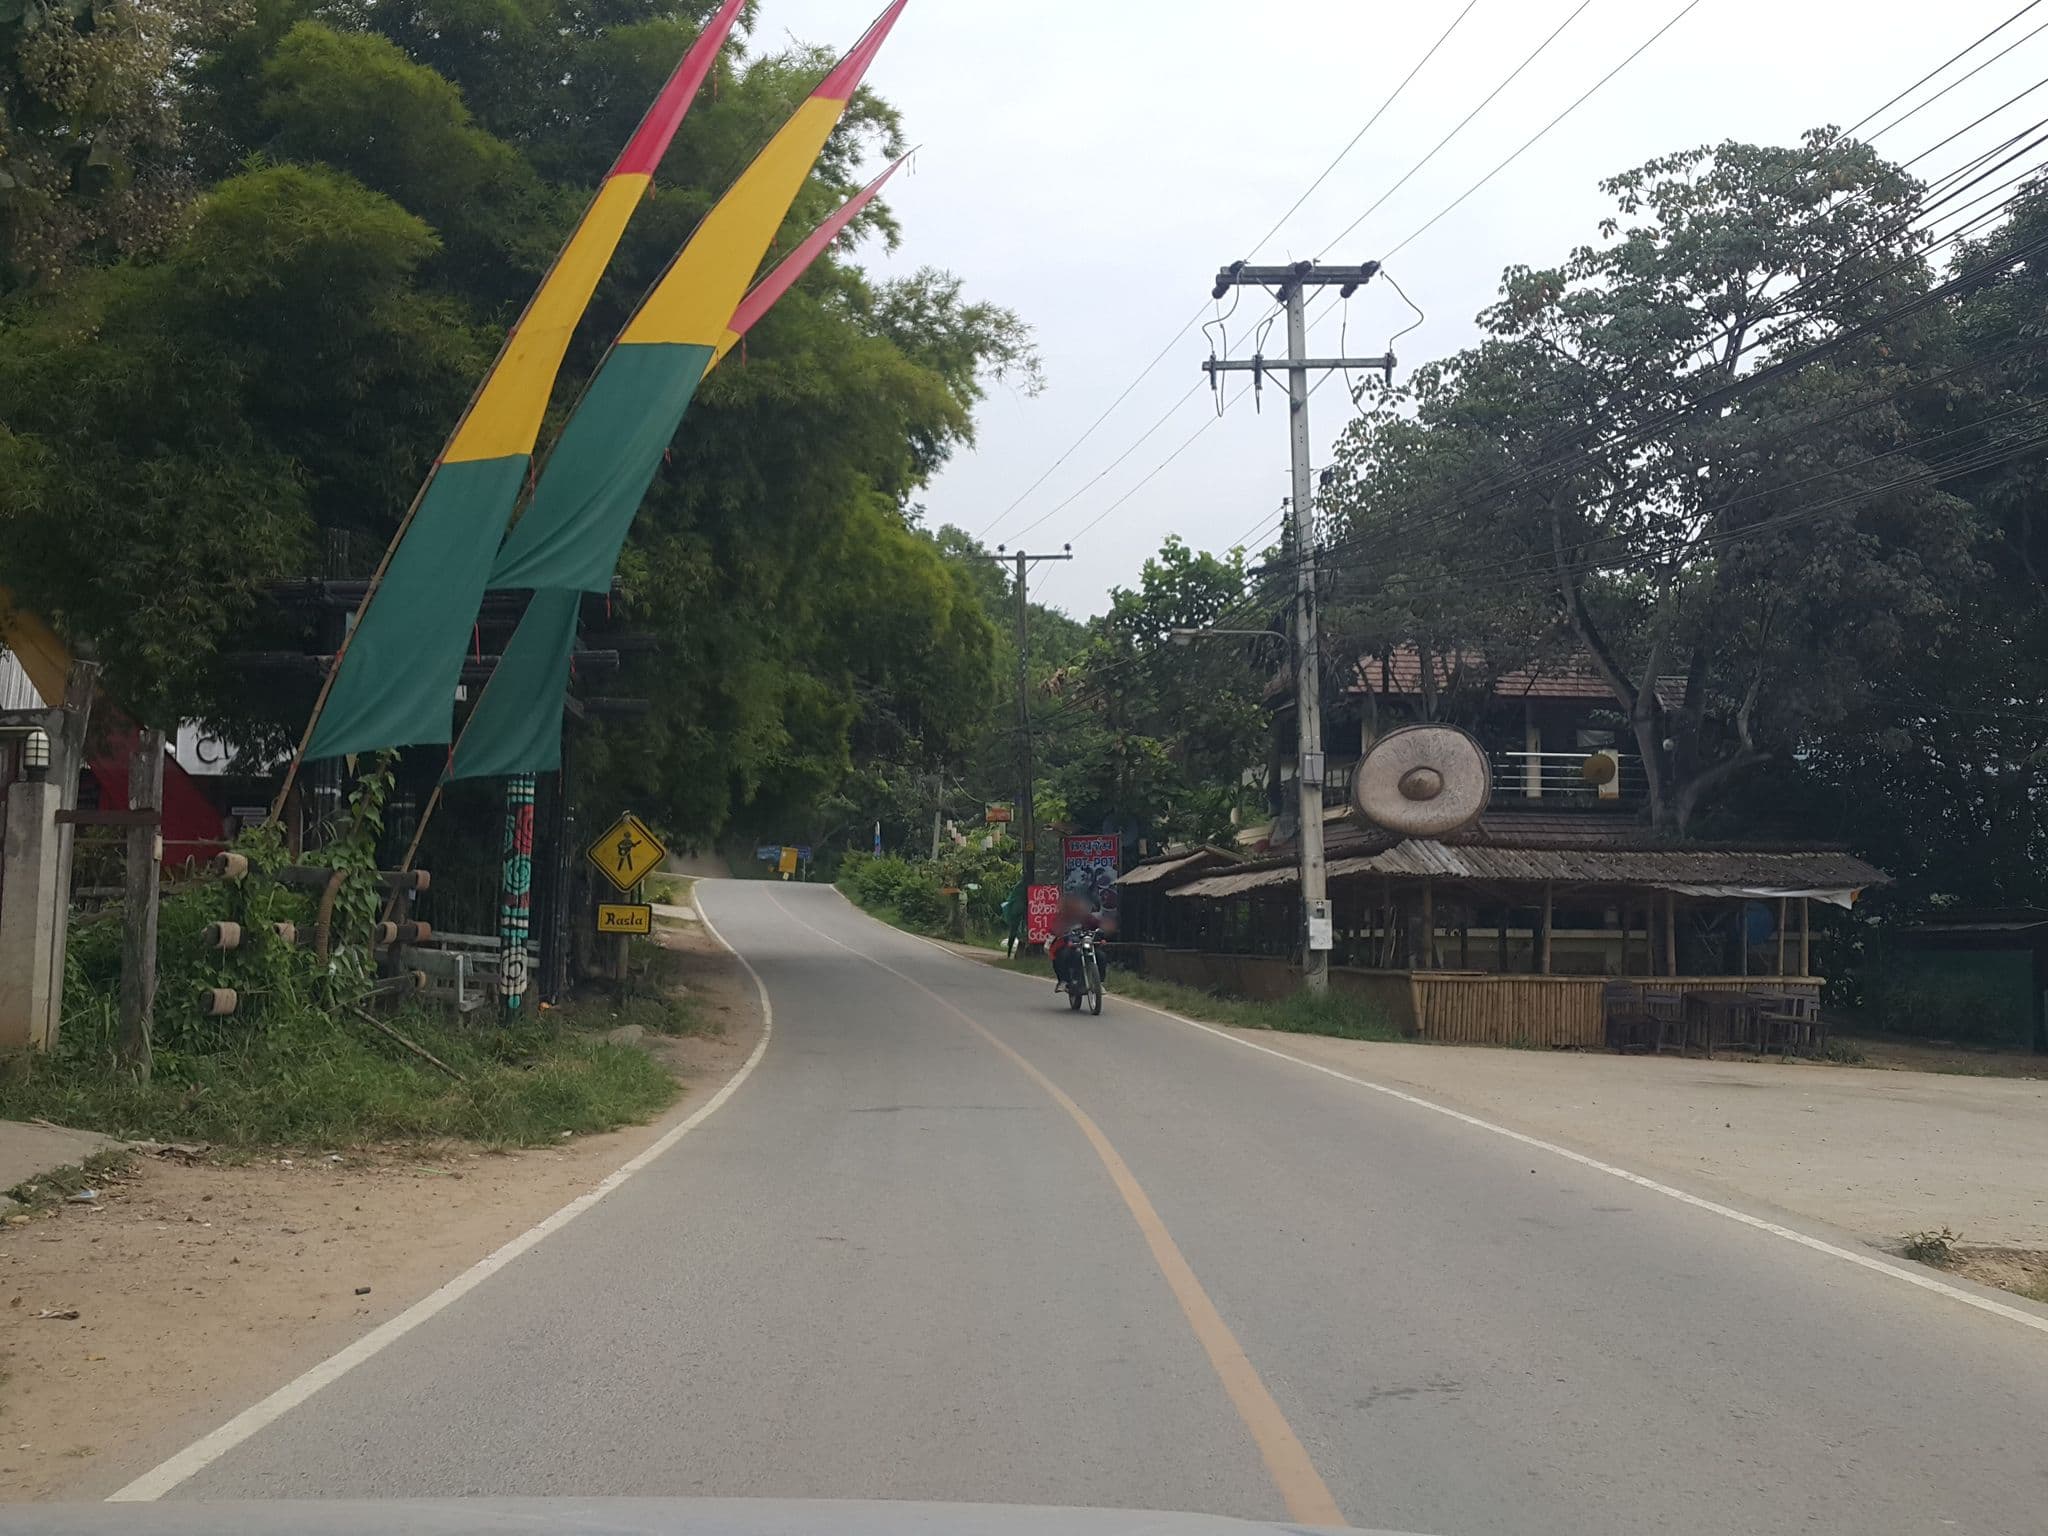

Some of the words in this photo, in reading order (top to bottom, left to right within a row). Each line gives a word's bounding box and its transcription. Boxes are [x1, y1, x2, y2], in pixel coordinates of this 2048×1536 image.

[1094, 857, 1114, 868] POT
[605, 911, 642, 925] Rasta
[1034, 916, 1048, 928] 91
